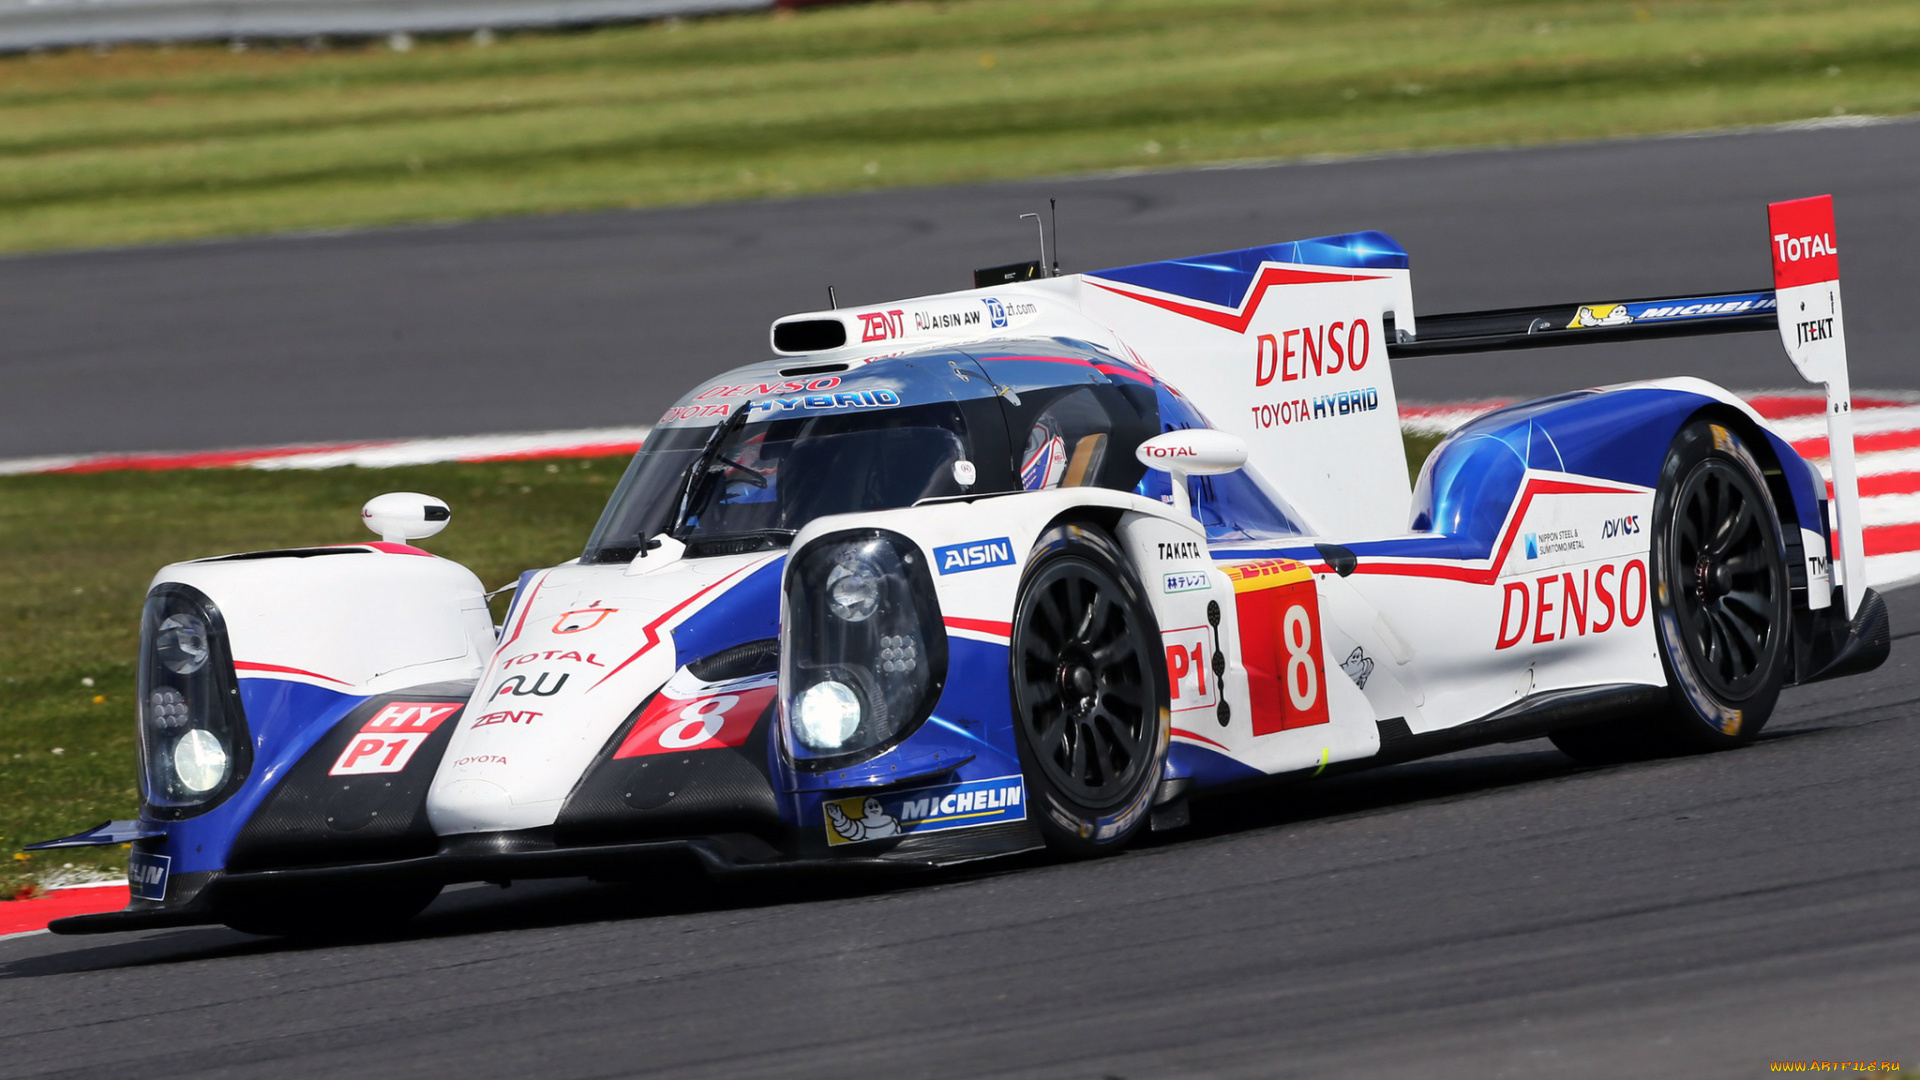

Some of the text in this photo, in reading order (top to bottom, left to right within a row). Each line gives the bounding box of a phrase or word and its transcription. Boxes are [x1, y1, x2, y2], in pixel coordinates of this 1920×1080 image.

[1774, 233, 1837, 262] TOTAL
[856, 309, 905, 342] ZENT
[932, 314, 962, 329] AISIN
[964, 311, 980, 325] AW
[1796, 317, 1834, 349] JTEKT
[1255, 318, 1370, 386] DENSO
[694, 376, 841, 400] DENSO
[660, 389, 900, 423] OYOTA HYBRID
[1252, 387, 1378, 429] TOYOTA HYBRID
[1143, 446, 1197, 458] TOTAL
[1158, 542, 1201, 560] TAKATA
[1538, 532, 1558, 543] NIPPON
[1559, 530, 1574, 540] STEEL
[1540, 540, 1584, 555] SUMITOMO METAL
[944, 542, 1009, 570] AISIN
[1495, 559, 1647, 650] DENSO
[503, 650, 605, 670] TOTAL
[1166, 642, 1207, 699] P1
[1283, 604, 1318, 711] 8
[370, 706, 453, 727] HY
[470, 710, 543, 730] ZENT
[658, 695, 740, 749] 8
[341, 738, 409, 768] P1
[453, 755, 507, 768] TOYOTA
[901, 786, 1021, 820] MICHELIN
